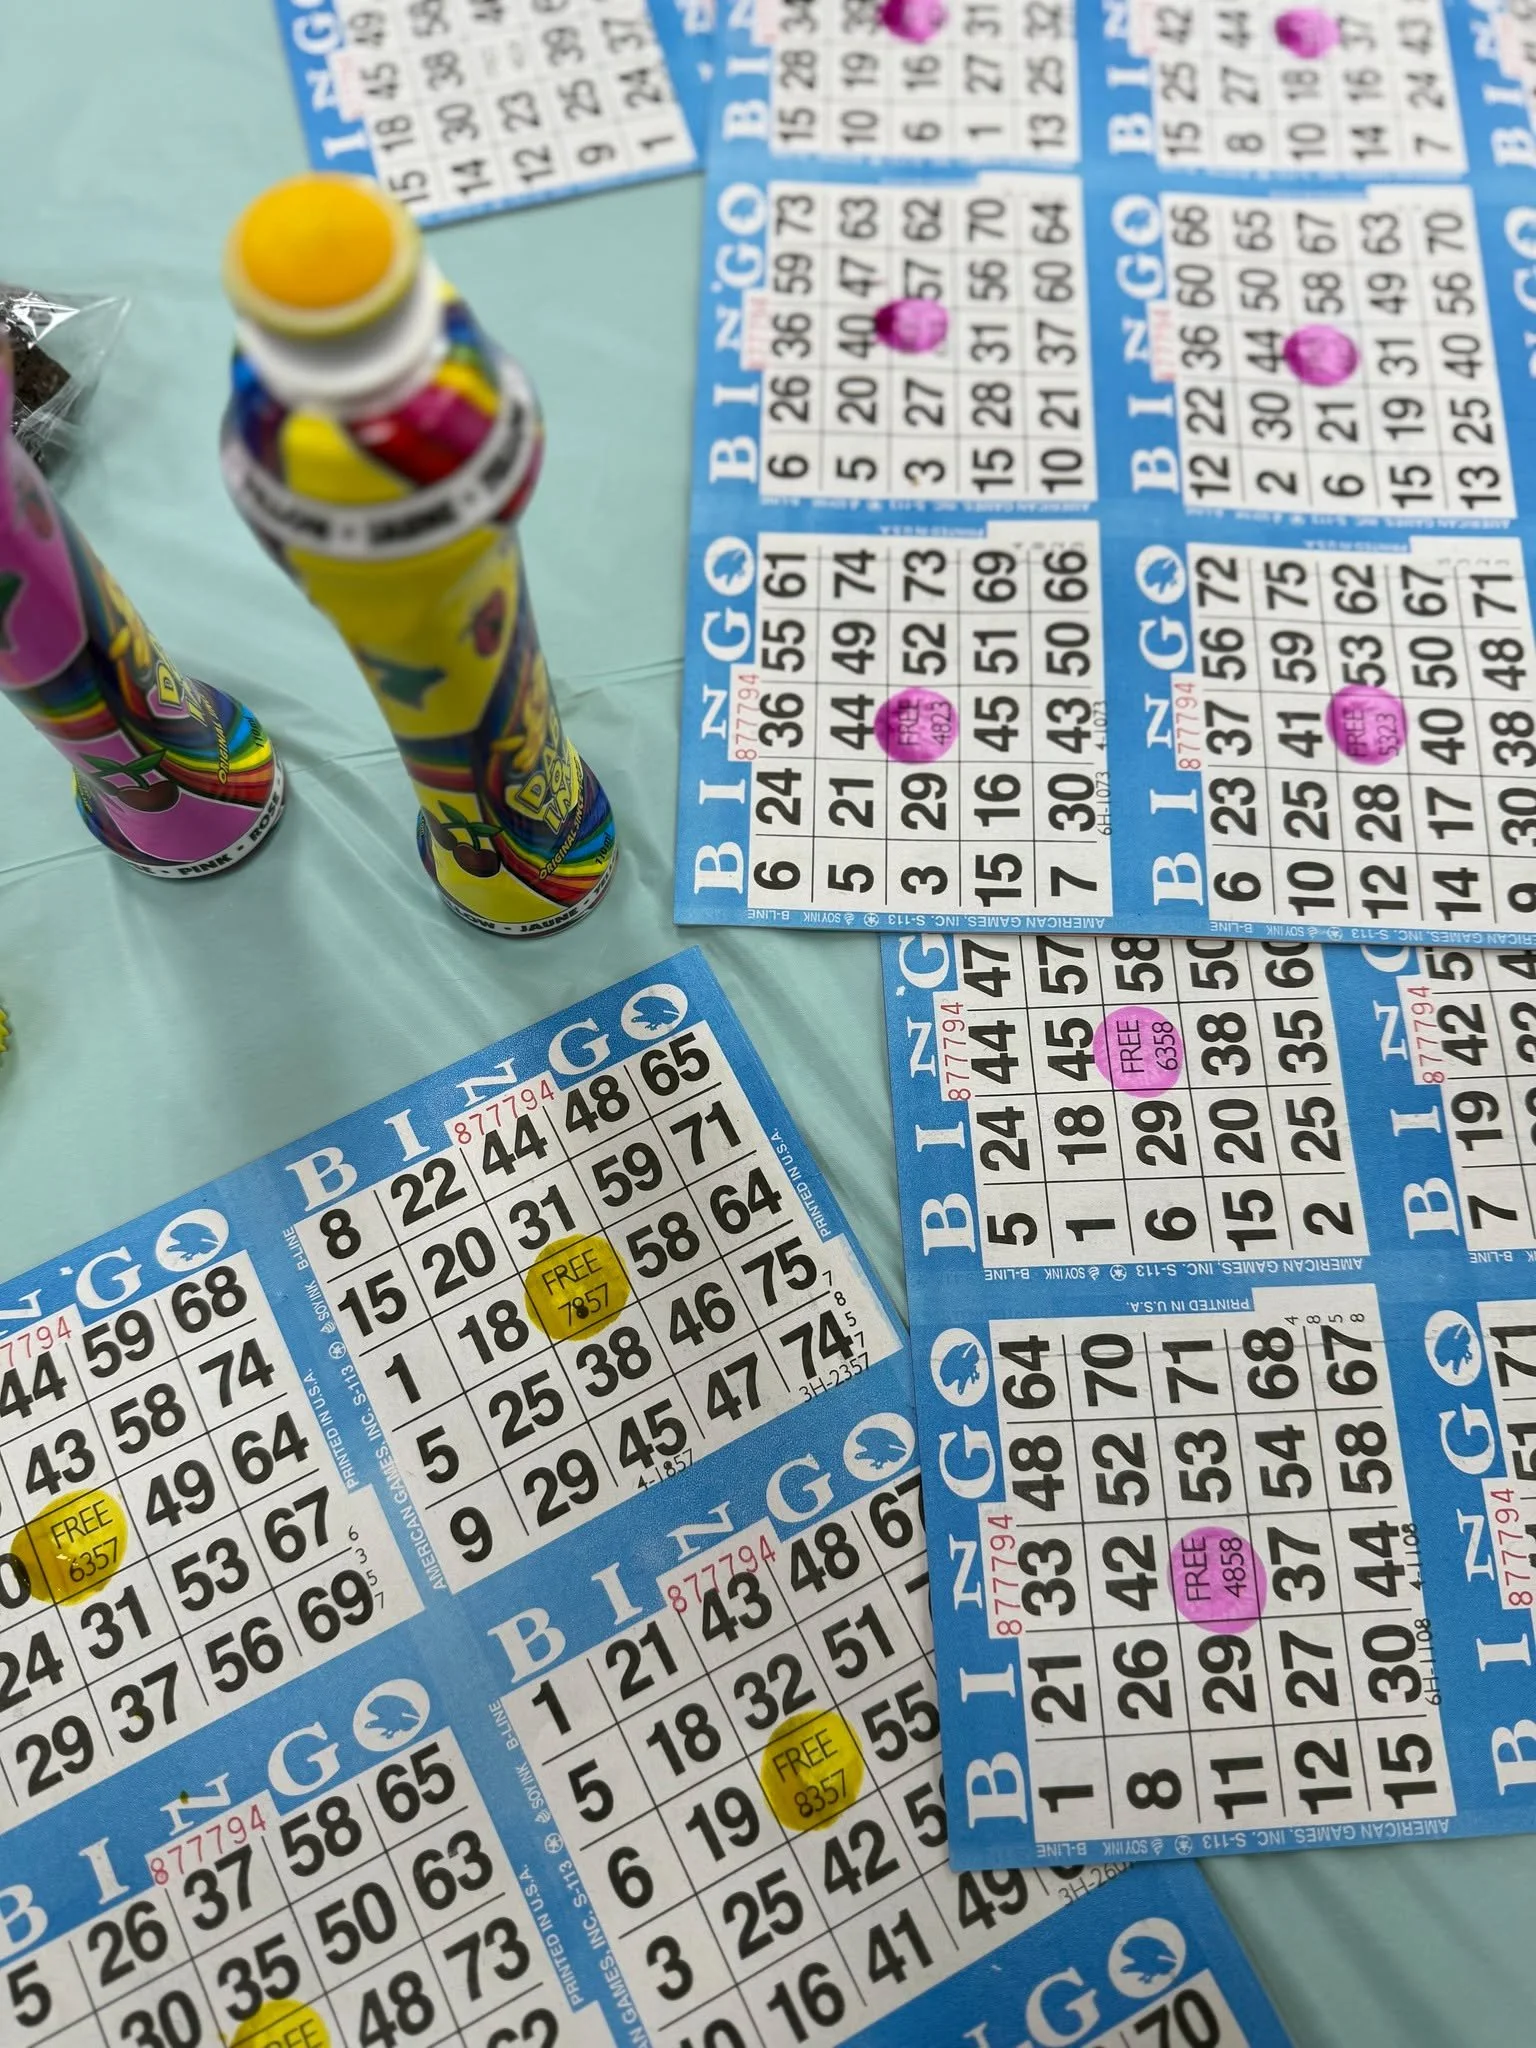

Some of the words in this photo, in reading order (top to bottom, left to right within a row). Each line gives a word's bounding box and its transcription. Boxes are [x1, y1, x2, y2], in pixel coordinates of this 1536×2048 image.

[965, 54, 1002, 93] 27
[436, 103, 479, 143] 30
[558, 79, 602, 120] 25
[778, 108, 815, 142] 15
[904, 122, 940, 142] 6
[1029, 114, 1066, 149] 13
[1163, 122, 1200, 156] 15
[1226, 133, 1263, 153] 8
[1288, 123, 1325, 160] 10
[1414, 136, 1449, 153] 7
[513, 147, 553, 183] 12
[578, 144, 615, 165] 9
[967, 198, 1005, 241] 70
[970, 325, 1010, 362] 31
[1180, 326, 1221, 369] 36
[769, 376, 810, 422] 26
[1382, 398, 1423, 439] 19
[1450, 399, 1493, 444] 25
[836, 458, 877, 480] 5
[973, 449, 1013, 492] 15
[1257, 471, 1297, 494] 2
[763, 554, 806, 598] 61
[1196, 557, 1239, 607] 72
[832, 621, 875, 674] 49
[1409, 637, 1457, 688] 50
[736, 672, 759, 760] 877794
[898, 697, 920, 746] FREE
[1175, 682, 1201, 770] 877794
[1347, 705, 1366, 758] FREE
[249, 793, 281, 842] ROSE
[901, 773, 947, 830] 29
[1353, 784, 1402, 842] 28
[178, 854, 233, 876] PINK
[539, 831, 577, 880] ORIGINAL
[1051, 867, 1097, 896] 7
[1433, 868, 1481, 921] 14
[520, 907, 580, 933] JAUNE
[748, 909, 790, 920] B-LINE
[888, 914, 926, 926] S-113
[932, 915, 959, 927] INC.
[1027, 918, 1105, 929] AMERICAN
[1210, 921, 1253, 934] B-LINE
[1352, 928, 1389, 940] S-113
[940, 1001, 971, 1101] 877794
[1117, 1020, 1145, 1074] FREE
[1153, 1020, 1180, 1072] 6358
[1197, 1012, 1250, 1075] 38
[1274, 1010, 1327, 1073] 35
[1405, 984, 1446, 1085] 877794
[453, 1077, 554, 1146] 877794
[1209, 1099, 1264, 1163] 20
[1451, 1091, 1502, 1151] 19
[772, 1128, 794, 1165] U.S.A.
[592, 1143, 662, 1207] 59
[788, 1166, 800, 1180] IN
[797, 1181, 831, 1237] PRINTED
[987, 1213, 1037, 1245] 5
[282, 1227, 309, 1272] B-LINE
[320, 1209, 361, 1259] 8
[1470, 1252, 1514, 1263] B-LINE
[541, 1249, 603, 1296] FREE
[742, 1237, 817, 1306] 75
[985, 1267, 1030, 1281] B-LINE
[1136, 1264, 1176, 1277] S-113
[1183, 1264, 1213, 1276] INC.
[1282, 1258, 1362, 1272] AMERICAN
[172, 1266, 247, 1333] 68
[1127, 1301, 1165, 1313] U.S.A.
[1169, 1299, 1185, 1312] IN
[1189, 1297, 1249, 1311] PRINTED
[303, 1369, 325, 1408] U.S.A.
[339, 1365, 367, 1406] S-113
[799, 1352, 871, 1403] 3H-2357
[999, 1335, 1055, 1409] 64
[318, 1405, 334, 1423] IN
[359, 1405, 382, 1441] INC.
[489, 1370, 564, 1448] 25
[326, 1423, 358, 1492] PRINTED
[1175, 1429, 1231, 1502] 53
[51, 1501, 113, 1550] FREE
[400, 1505, 448, 1591] AMERICAN
[1489, 1487, 1533, 1607] 877794
[70, 1538, 120, 1584] 6357
[172, 1538, 249, 1611] 53
[668, 1534, 777, 1613] 877794
[988, 1514, 1023, 1637] 877794
[1185, 1537, 1212, 1603] FREE
[1217, 1536, 1246, 1600] 4858
[606, 1622, 677, 1700] 21
[1113, 1639, 1172, 1719] 26
[488, 1701, 519, 1751] B-LINE
[16, 1716, 93, 1796] 29
[772, 1729, 840, 1784] FREE
[1295, 1739, 1352, 1814] 12
[377, 1743, 455, 1823] 65
[794, 1769, 847, 1818] 8357
[149, 1804, 266, 1886] 877794
[686, 1787, 759, 1860] 19
[1202, 1832, 1246, 1849] S-113
[1253, 1829, 1286, 1846] INC.
[1362, 1818, 1450, 1838] AMERICAN
[825, 1820, 899, 1894] 42
[1037, 1841, 1087, 1858] B-LINE
[519, 1864, 545, 1911] U.S.A.
[558, 1859, 588, 1908] S-113
[316, 1883, 396, 1964] 50
[536, 1913, 554, 1935] IN
[582, 1908, 606, 1949] INC.
[548, 1933, 584, 2007] PRINTED
